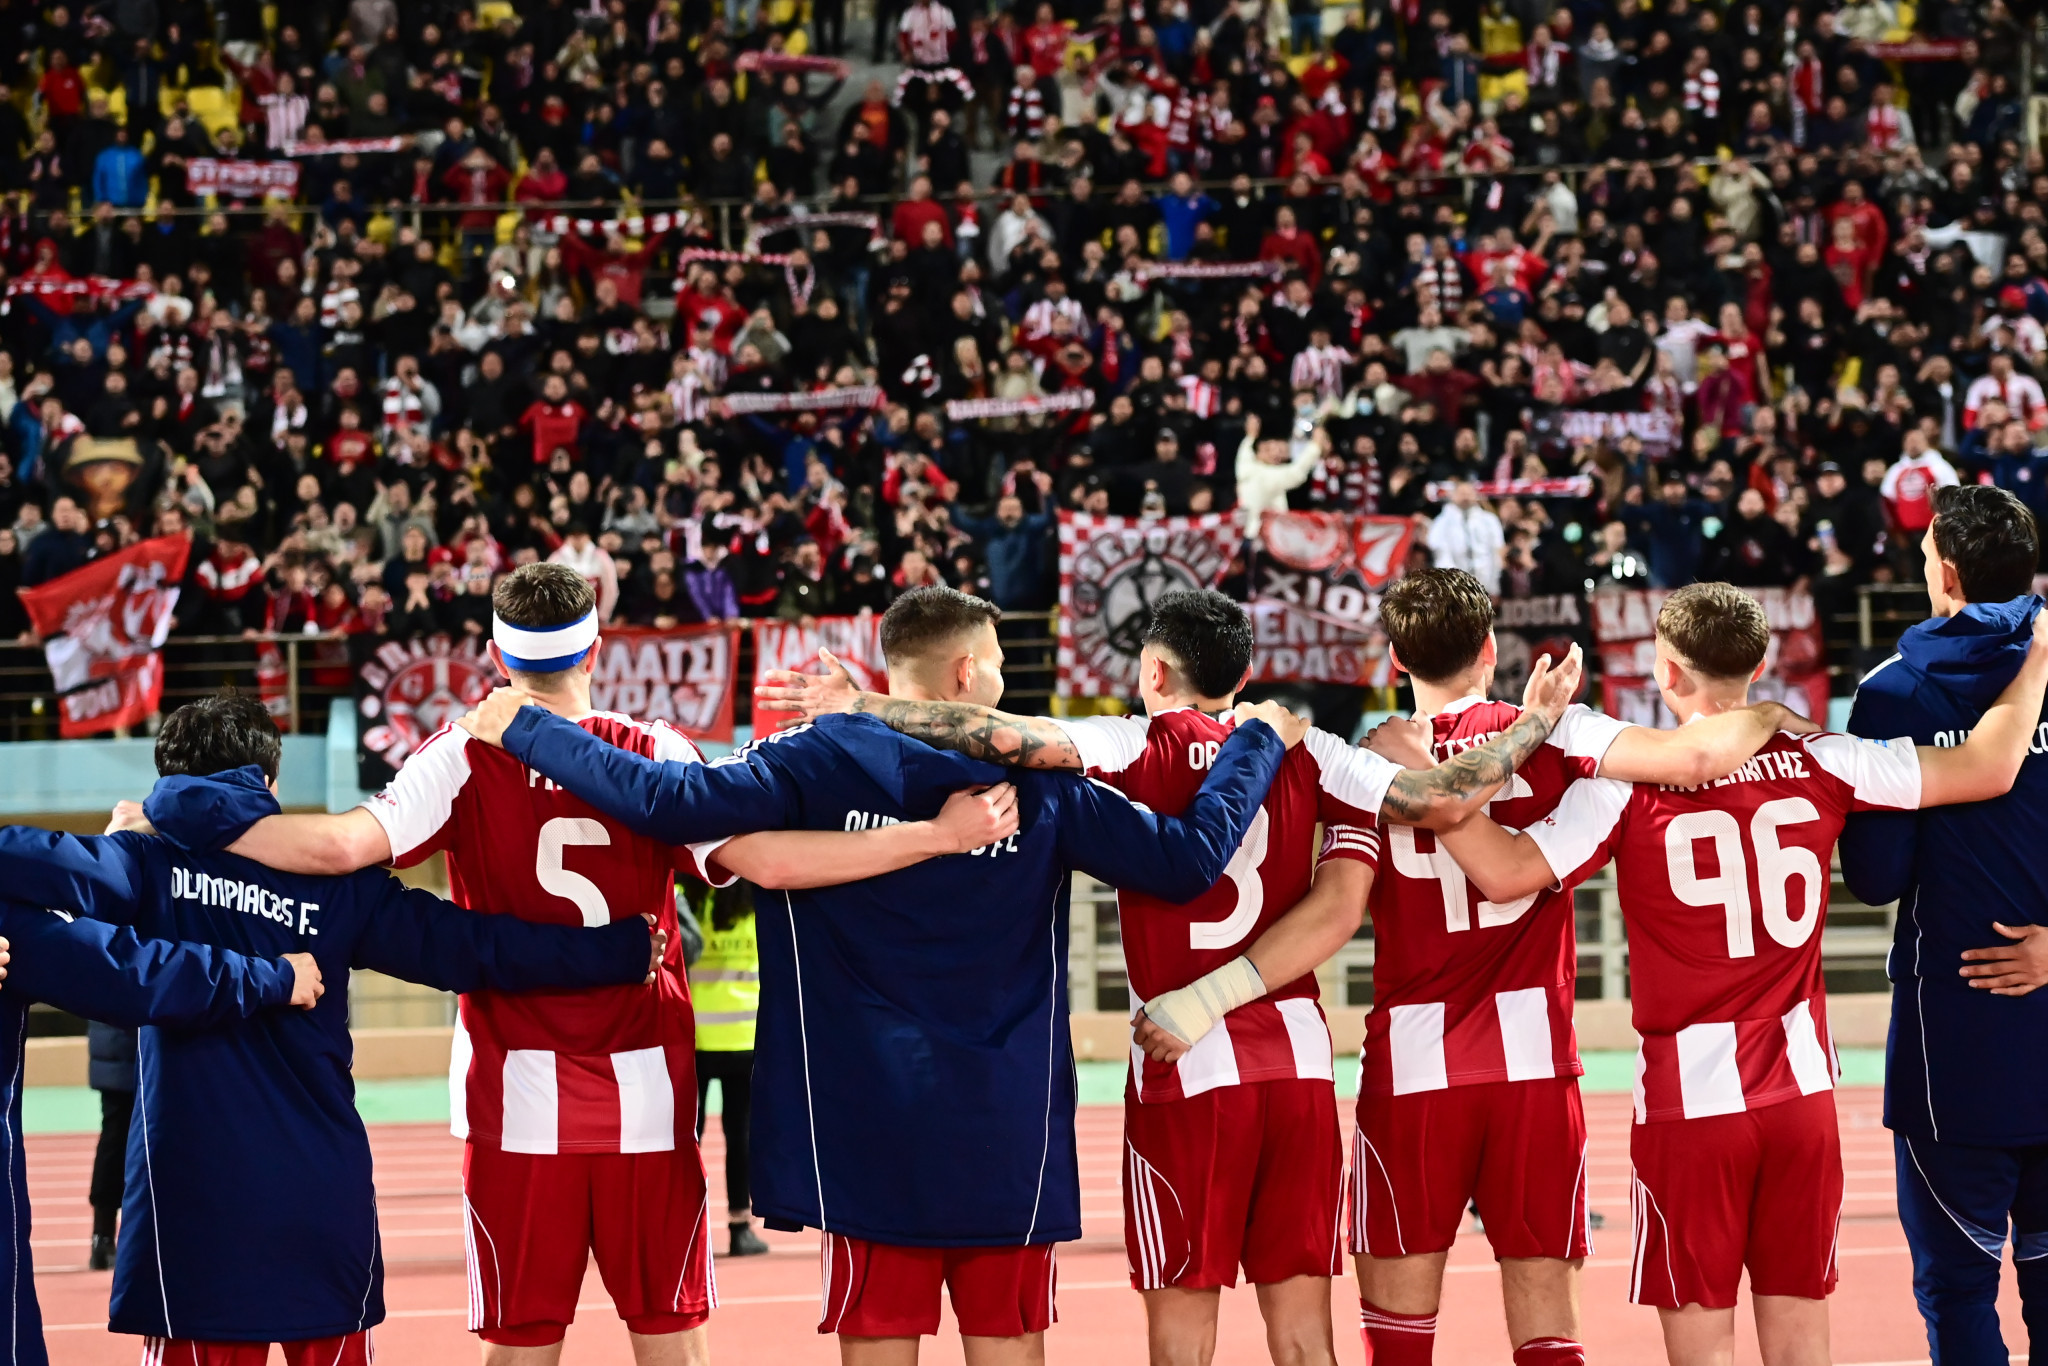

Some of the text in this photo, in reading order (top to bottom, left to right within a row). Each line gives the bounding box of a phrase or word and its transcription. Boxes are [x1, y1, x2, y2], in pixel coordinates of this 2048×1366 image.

[1360, 523, 1406, 577] 7
[536, 817, 611, 928] 5
[1665, 797, 1822, 959] 96
